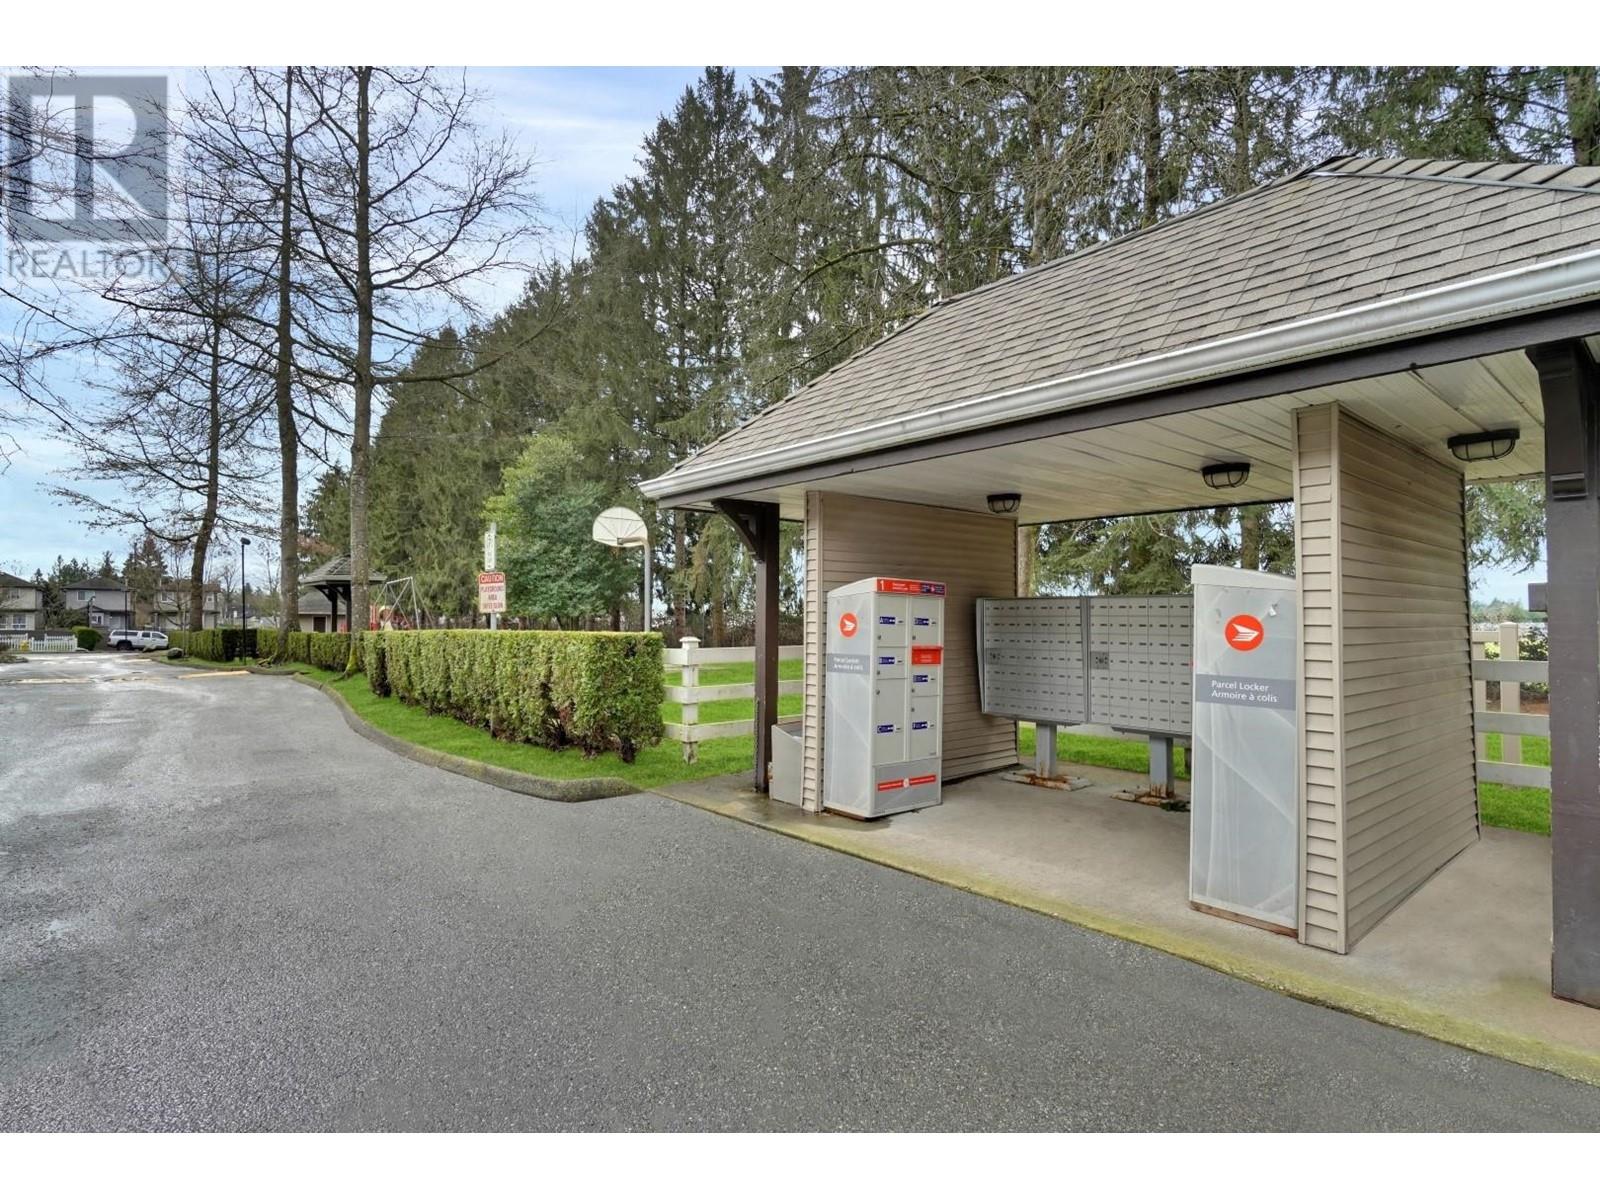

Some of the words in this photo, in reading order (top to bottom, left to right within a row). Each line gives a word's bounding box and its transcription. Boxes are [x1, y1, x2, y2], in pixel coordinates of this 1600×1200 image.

[1211, 680, 1237, 689] Parcel
[1239, 682, 1270, 692] Locker
[1211, 690, 1247, 700] Armoire
[1257, 694, 1278, 703] colis
